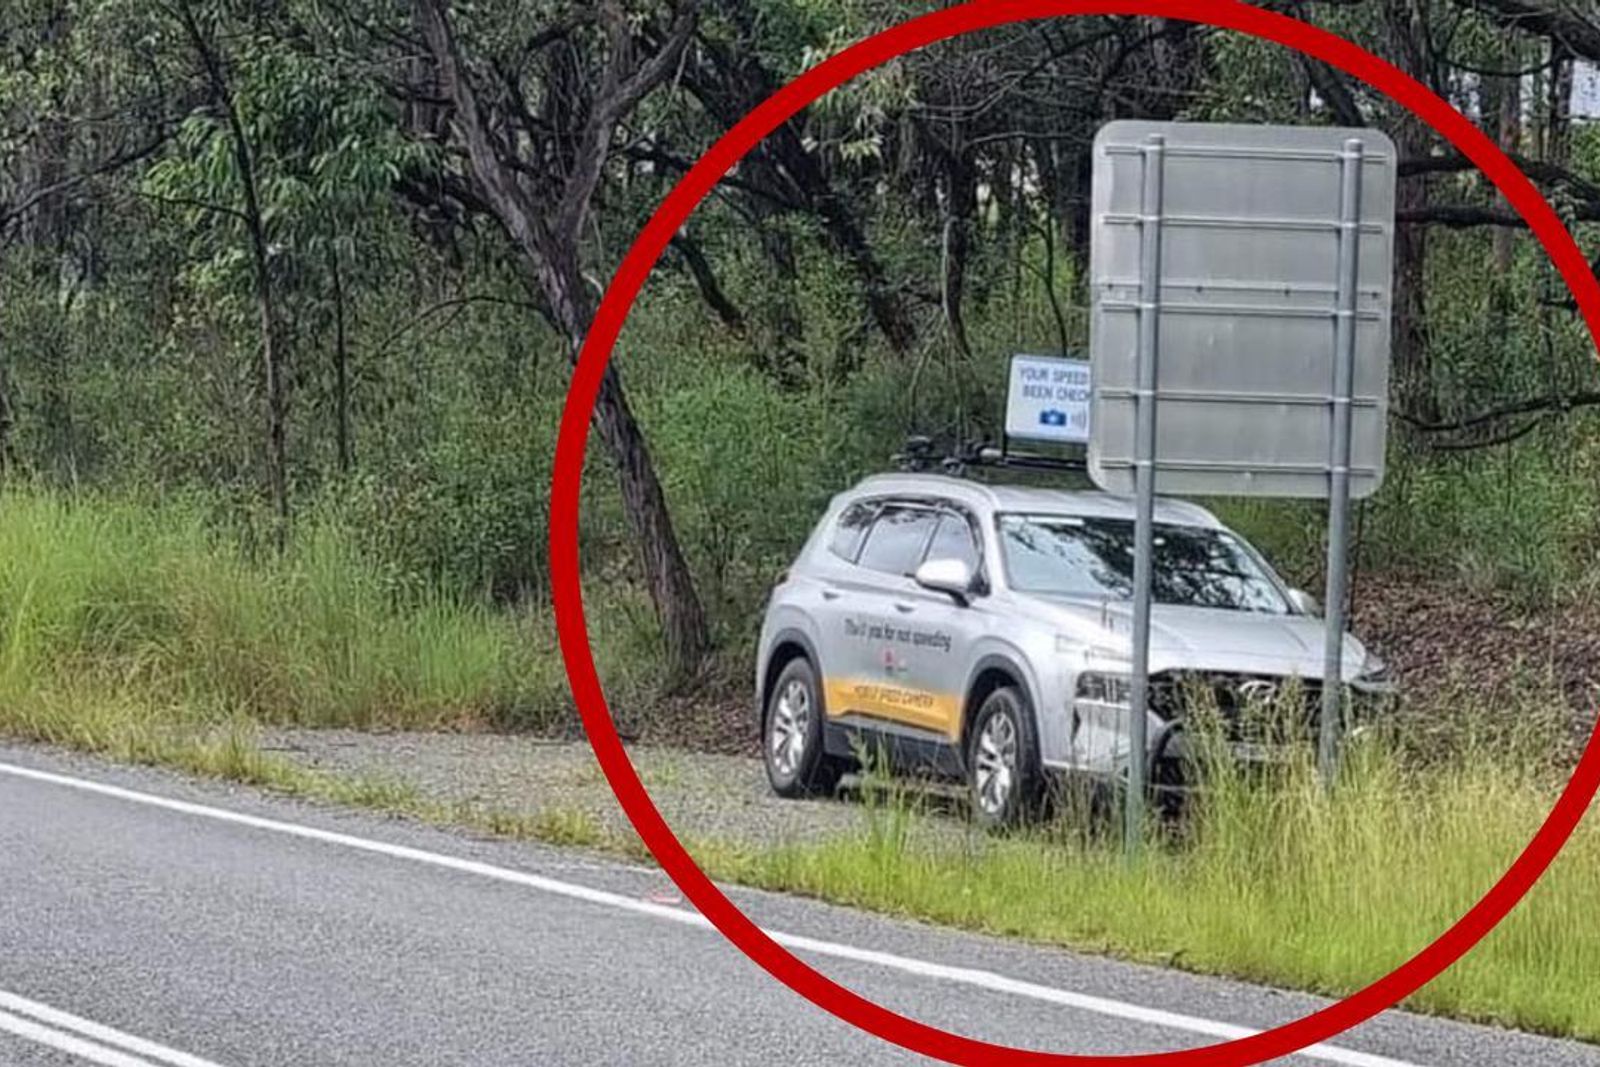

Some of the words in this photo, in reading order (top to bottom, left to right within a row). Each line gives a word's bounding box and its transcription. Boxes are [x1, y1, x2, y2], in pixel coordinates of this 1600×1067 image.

[1020, 367, 1049, 381] YOUR
[1053, 370, 1089, 385] SPEED
[1023, 385, 1053, 399] BEEN
